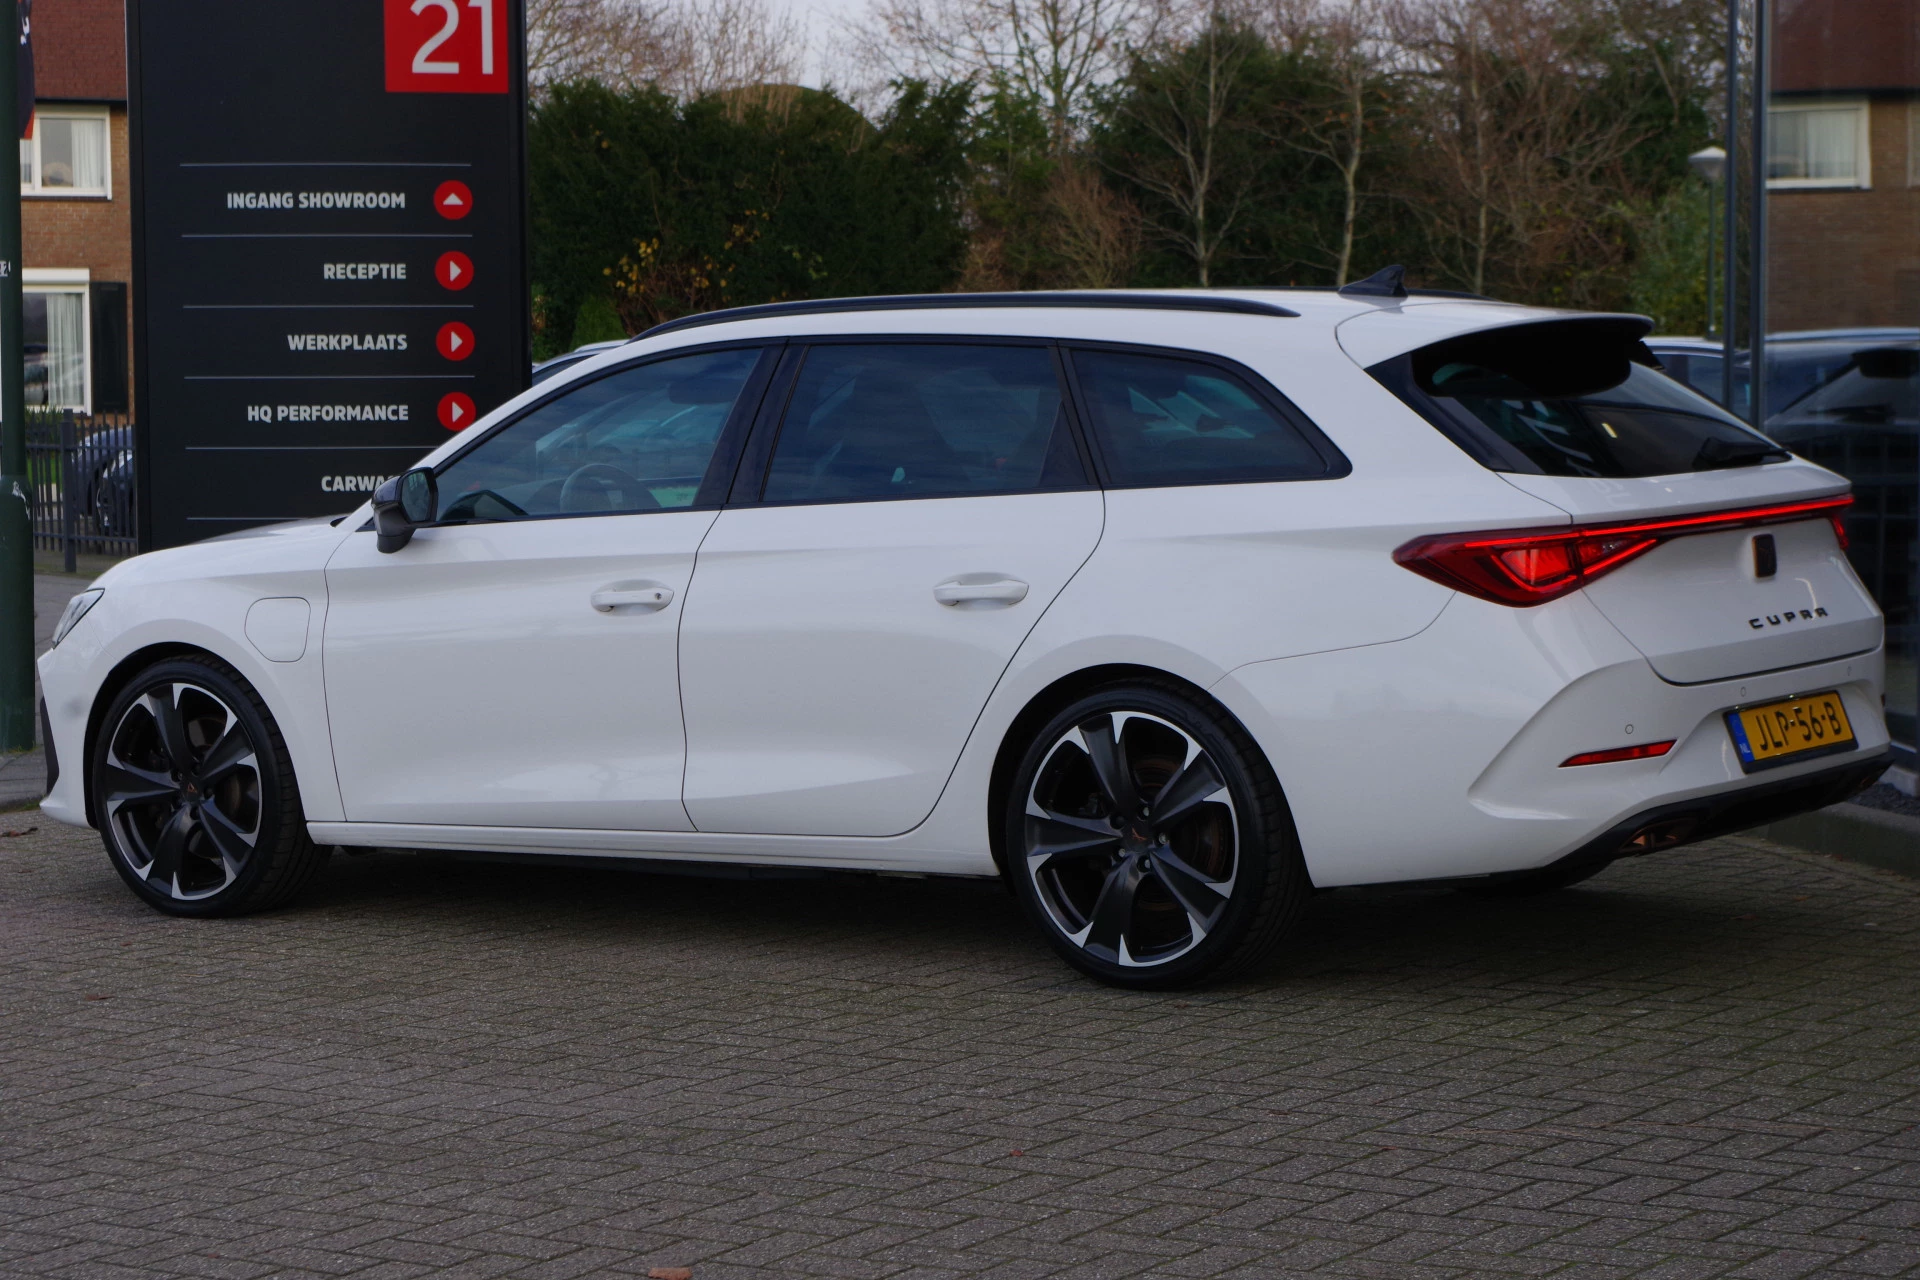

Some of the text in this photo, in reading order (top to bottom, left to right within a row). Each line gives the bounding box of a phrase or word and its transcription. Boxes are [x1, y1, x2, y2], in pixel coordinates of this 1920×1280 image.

[410, 0, 494, 75] 21
[227, 192, 406, 209] INGANG SHOWROOM
[323, 263, 407, 280] RECEPTIE
[287, 334, 408, 351] WERKPLAATS
[247, 404, 409, 423] HQ PERFORMANCE
[321, 475, 393, 492] CARWA
[1749, 607, 1828, 629] CUPRA
[1756, 702, 1842, 751] JLP-56-B
